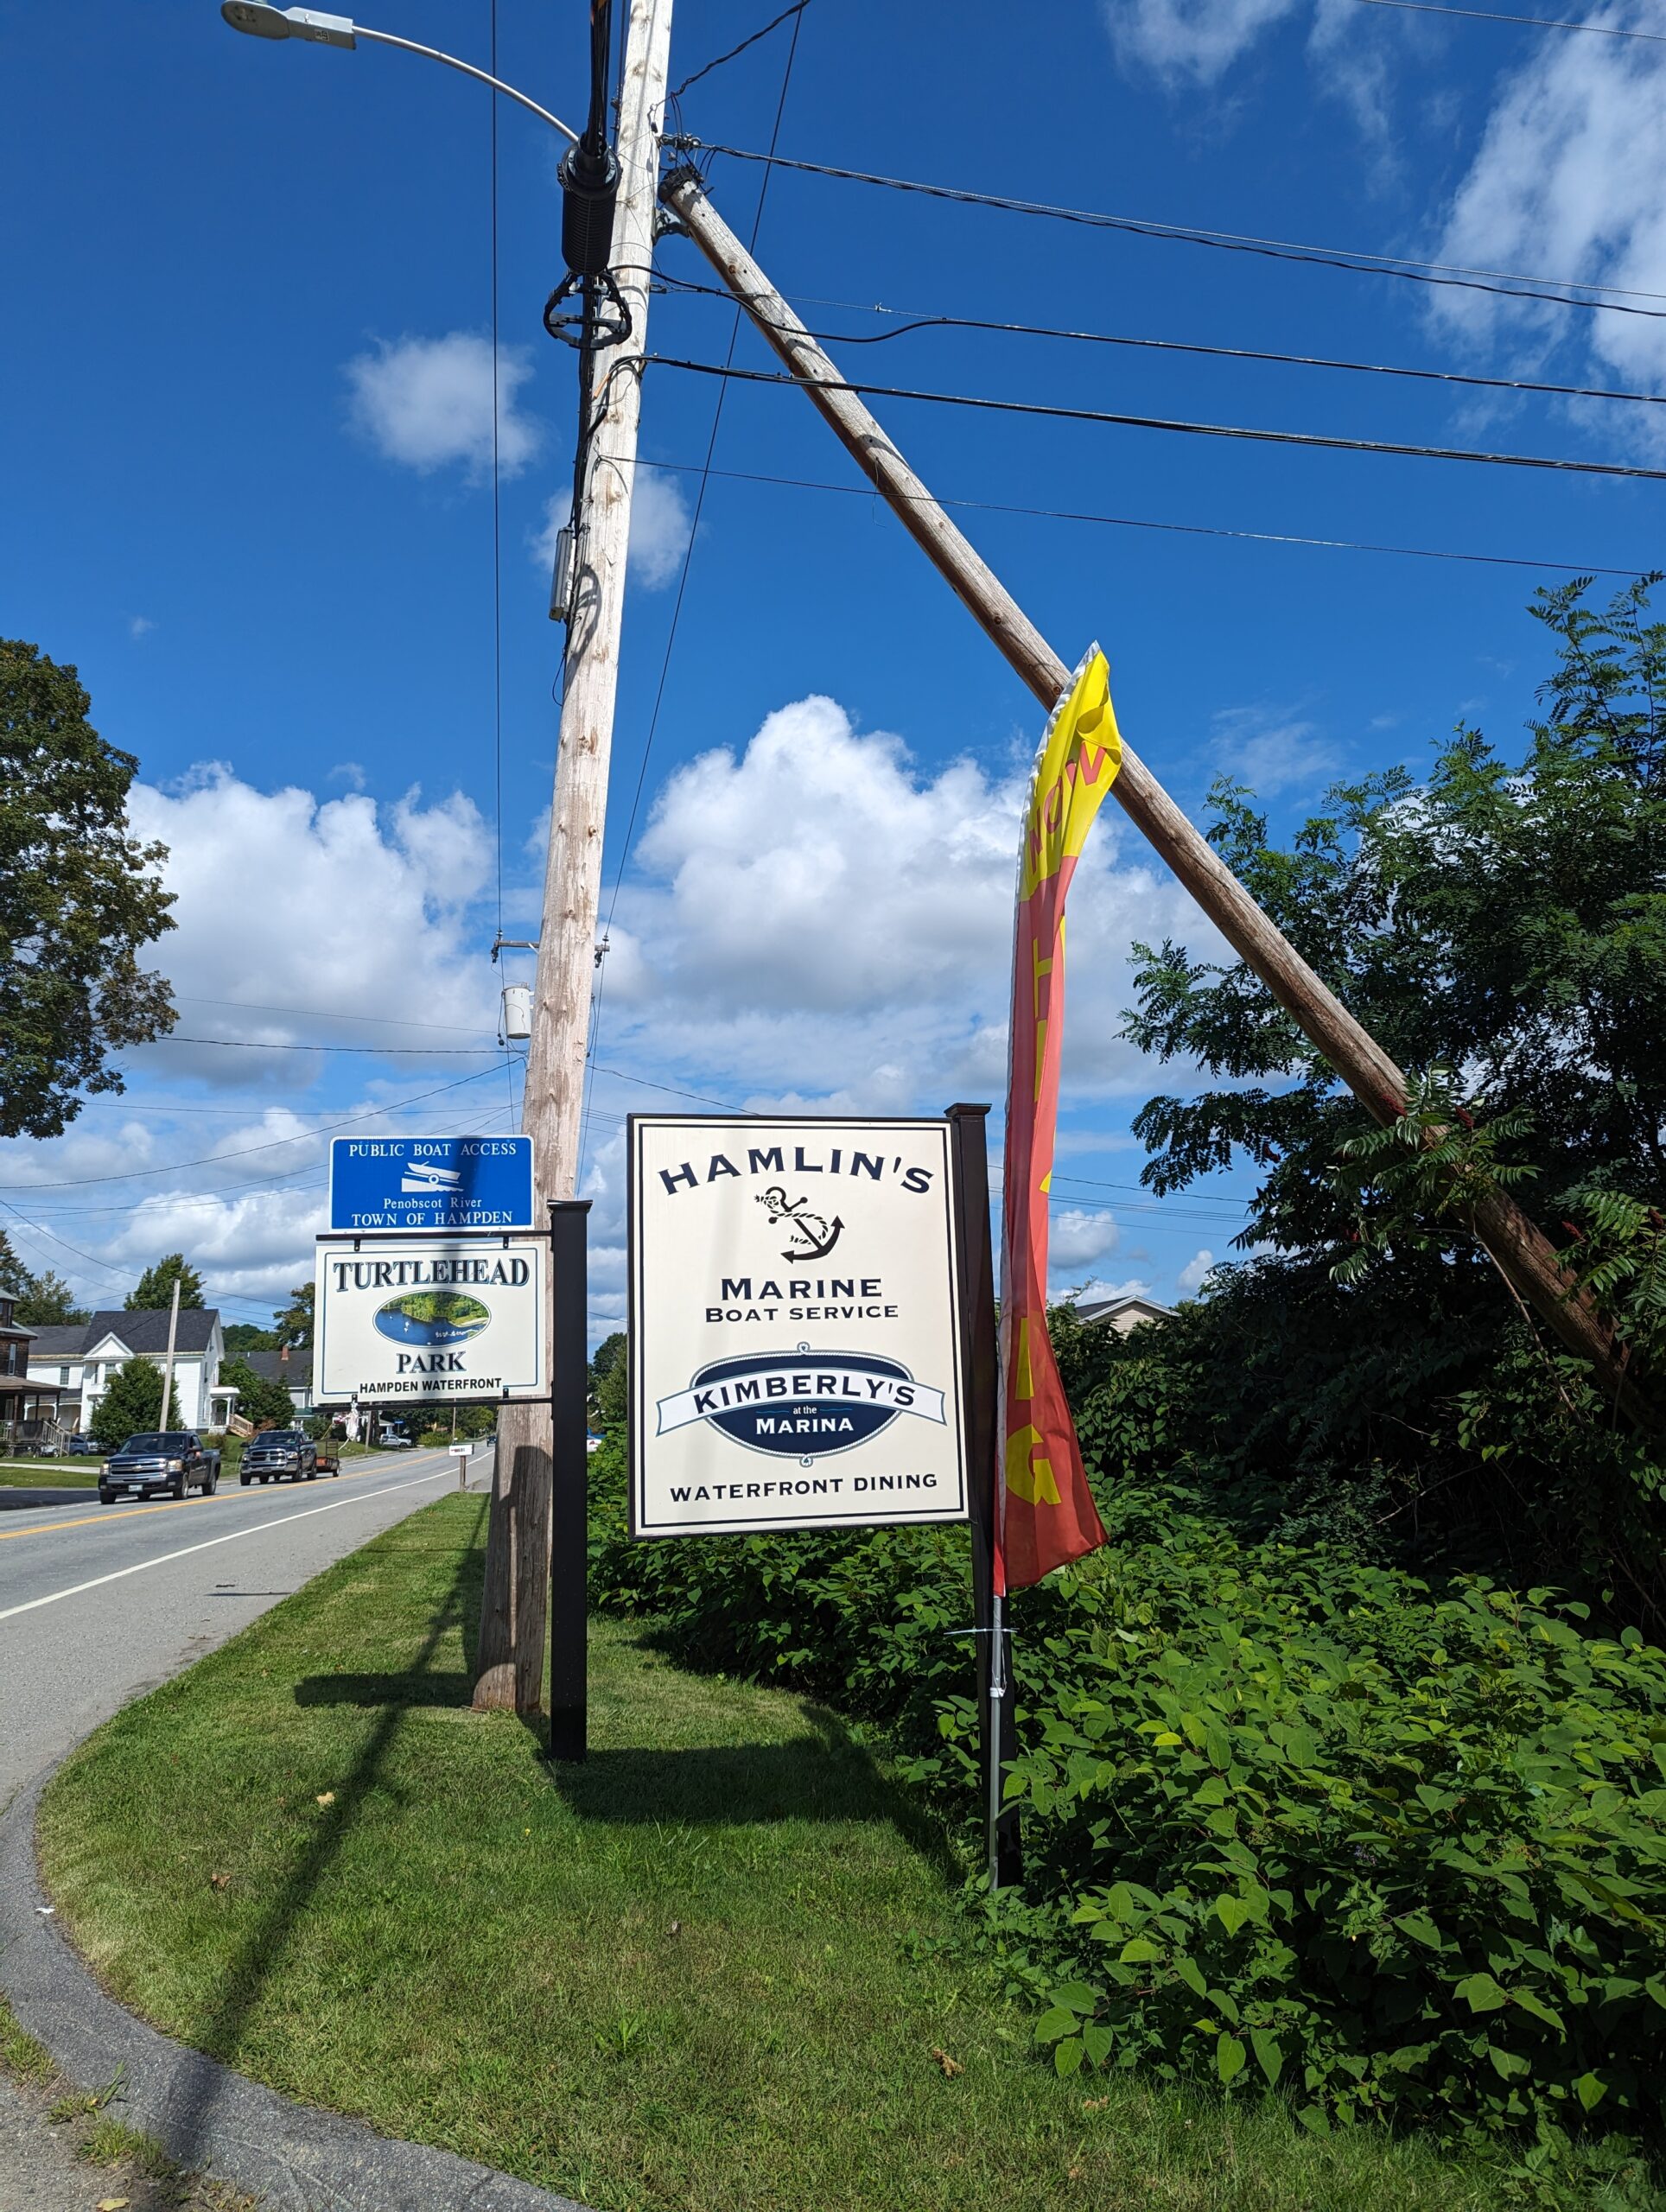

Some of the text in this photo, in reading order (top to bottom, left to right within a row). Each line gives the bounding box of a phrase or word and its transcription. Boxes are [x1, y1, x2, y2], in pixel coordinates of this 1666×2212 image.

[348, 1142, 517, 1157] PUBLIC BOAT ACCESS
[657, 1146, 935, 1196] HAMLIN'S
[383, 1198, 482, 1210] Penobscot River
[351, 1211, 512, 1227] TOWN OF HAMPDEN
[332, 1257, 531, 1293] TURTLEHEAD
[721, 1277, 882, 1301] MARINE
[705, 1305, 899, 1323] BOAT SERVICE
[396, 1351, 467, 1374] PARK
[359, 1377, 502, 1394] HAMPDEN WATERFRONT
[692, 1374, 916, 1414] KIMBERLY'S
[803, 1405, 817, 1414] the
[755, 1417, 855, 1435] MARINA
[670, 1473, 938, 1503] WATERFRONT DINING
